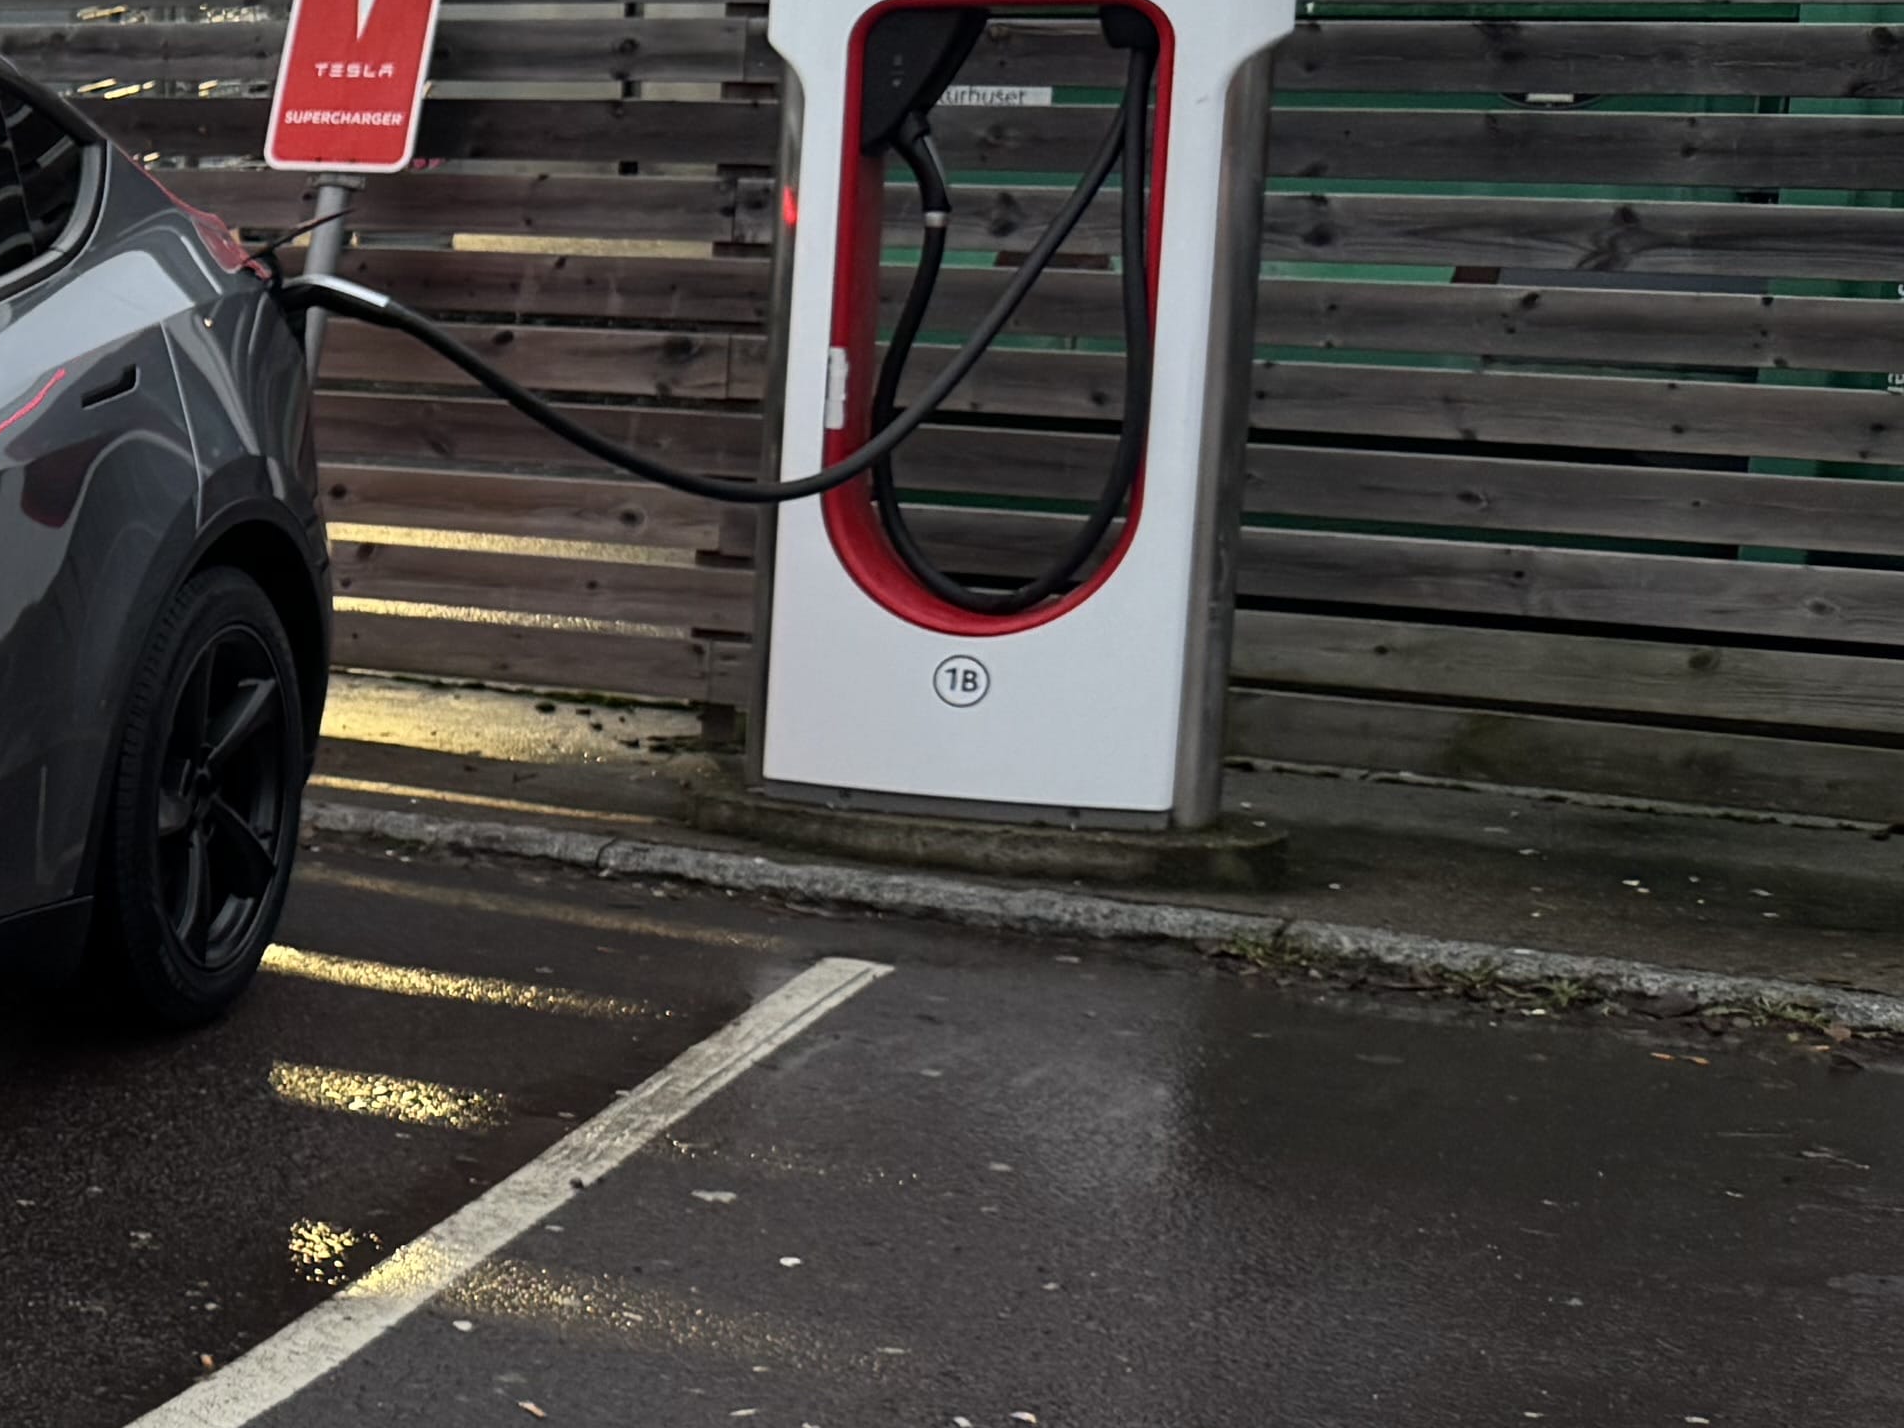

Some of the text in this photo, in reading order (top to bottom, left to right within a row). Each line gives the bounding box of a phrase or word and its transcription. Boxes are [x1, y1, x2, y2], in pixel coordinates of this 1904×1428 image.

[314, 62, 395, 79] TESLA
[284, 110, 403, 127] SUPERCHARGER
[944, 668, 978, 692] 1B
